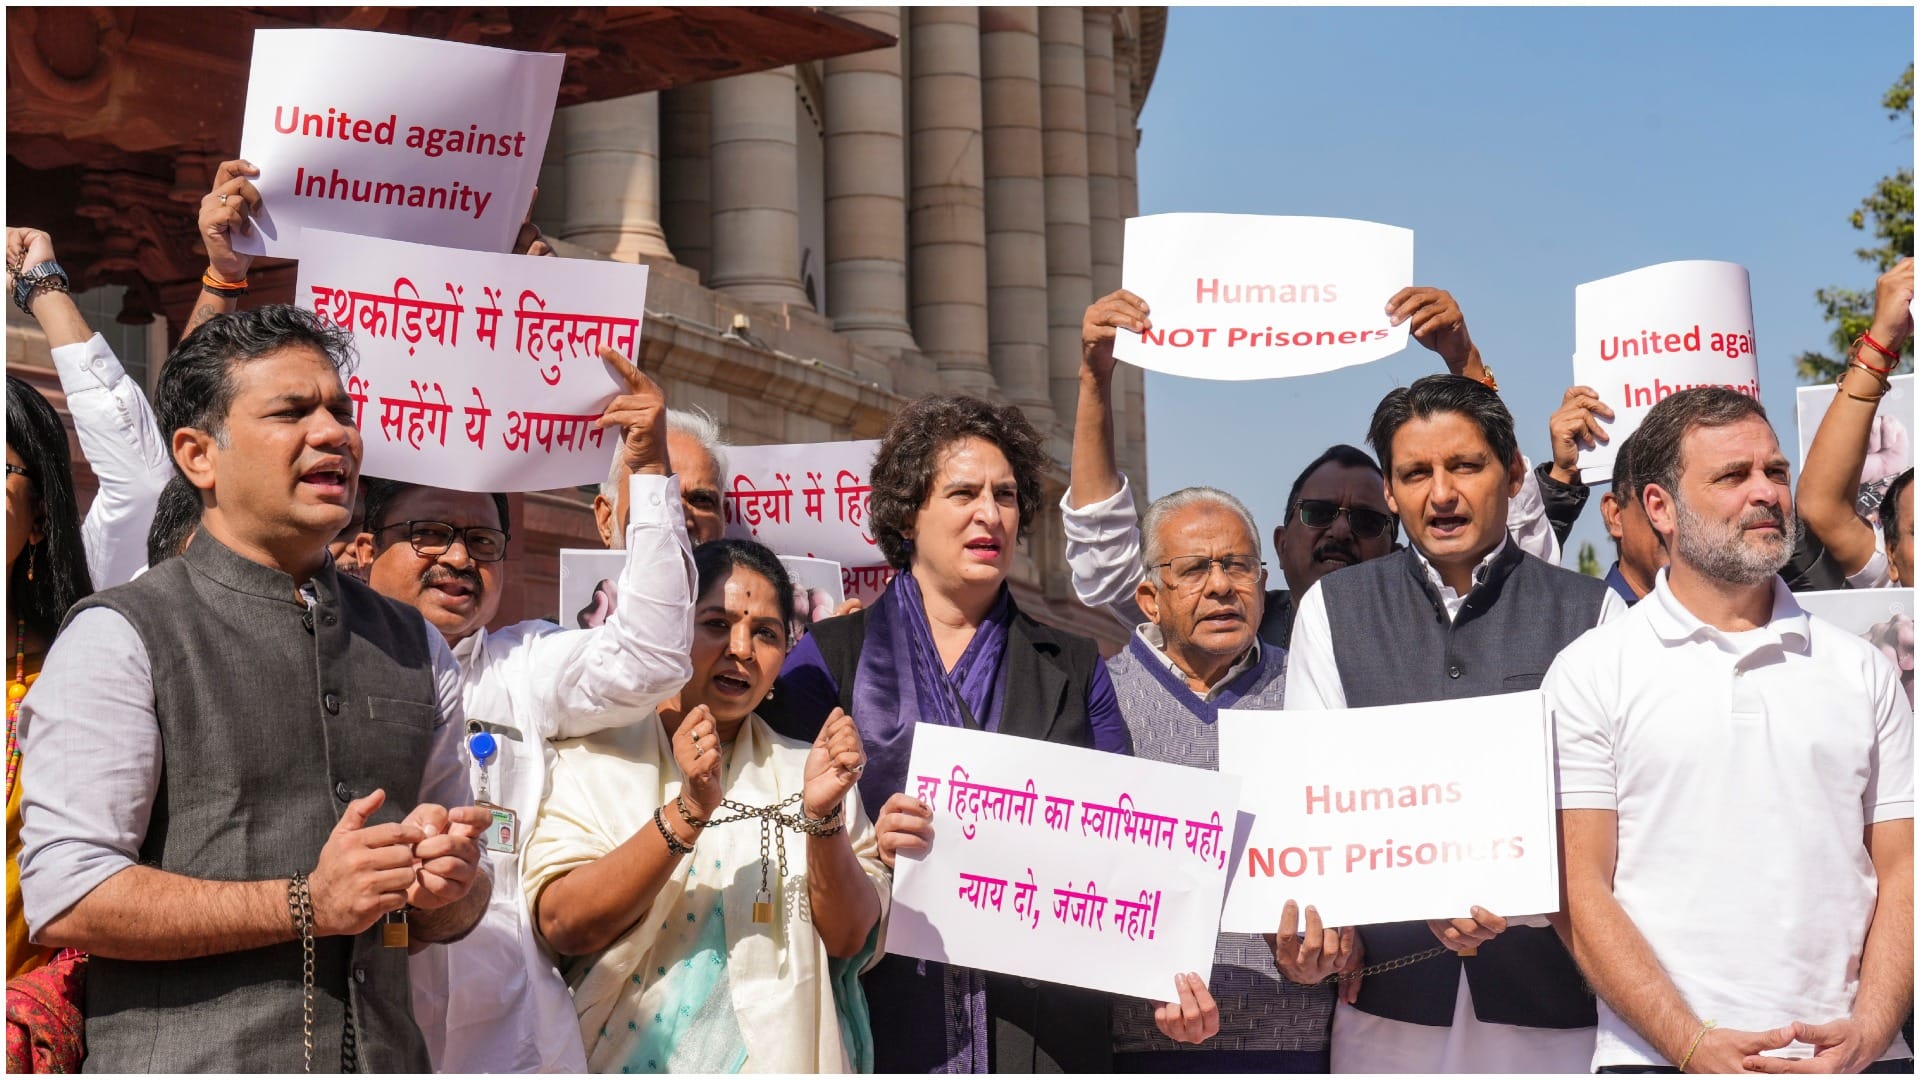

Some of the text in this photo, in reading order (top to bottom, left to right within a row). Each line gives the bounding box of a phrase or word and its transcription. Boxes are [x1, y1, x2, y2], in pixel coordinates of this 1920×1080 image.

[275, 106, 526, 158] United against
[294, 166, 492, 219] Inhumanity
[1196, 278, 1336, 304] Humans
[475, 285, 504, 351] में
[514, 290, 640, 386] हिंदुस्तान
[1141, 326, 1389, 348] NOT Prisoners
[1601, 325, 1756, 361] United agai
[379, 379, 454, 451] सहेंगे
[463, 386, 493, 451] ये
[503, 411, 604, 453] अपमान
[801, 471, 827, 523] में
[917, 765, 1226, 869] हर हिंदुस्तानी का स्वाभिमान यही,
[1305, 781, 1462, 815] Humans
[1249, 847, 1332, 878] NOT
[958, 867, 1162, 941] न्याय दो, जंजीर नहीं!
